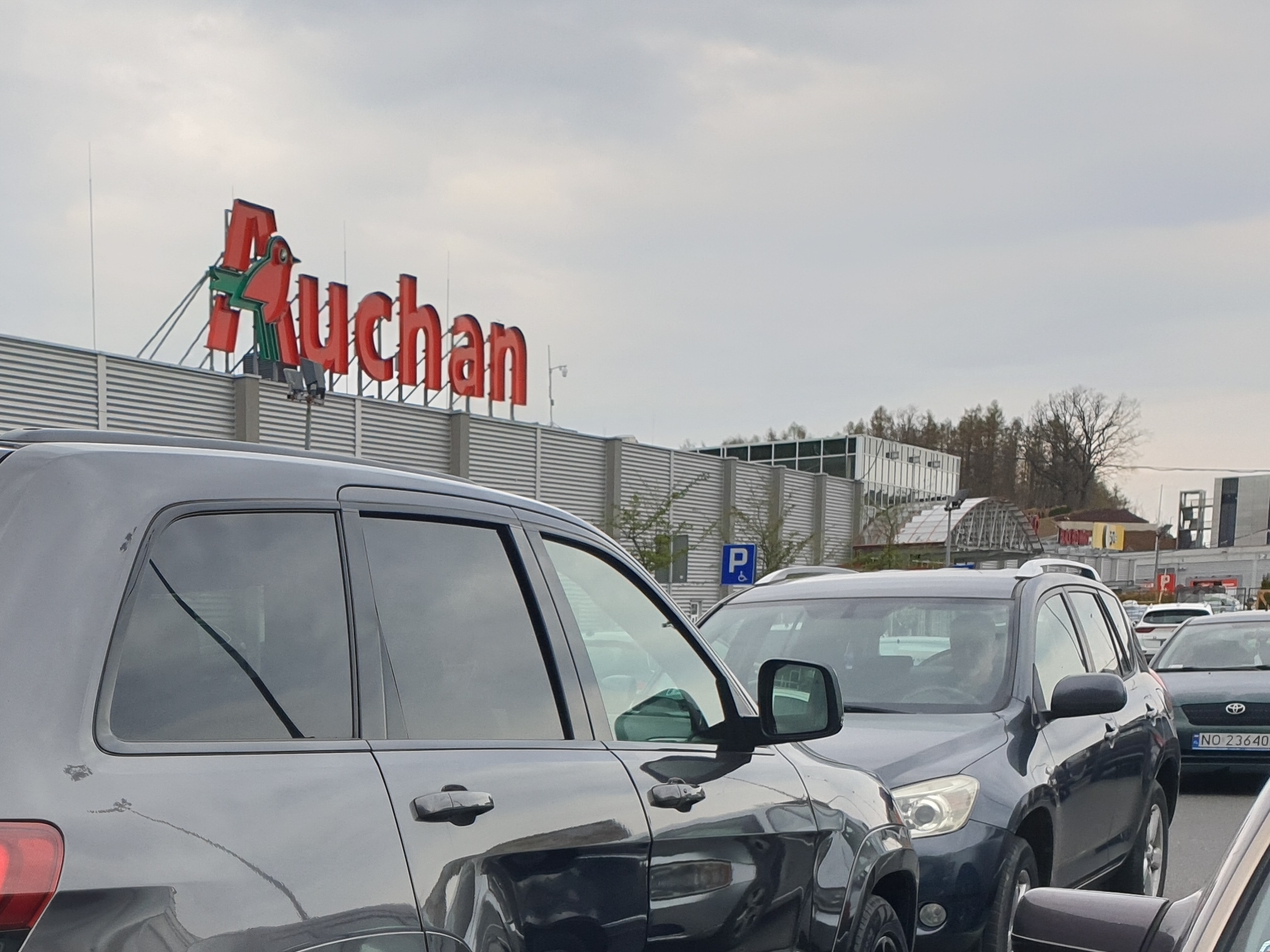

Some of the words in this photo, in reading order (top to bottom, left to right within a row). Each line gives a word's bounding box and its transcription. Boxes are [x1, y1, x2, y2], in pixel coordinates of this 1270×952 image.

[206, 198, 527, 406] Auchan
[728, 547, 749, 574] P
[1201, 734, 1221, 746] NO
[1225, 734, 1269, 747] 23640
